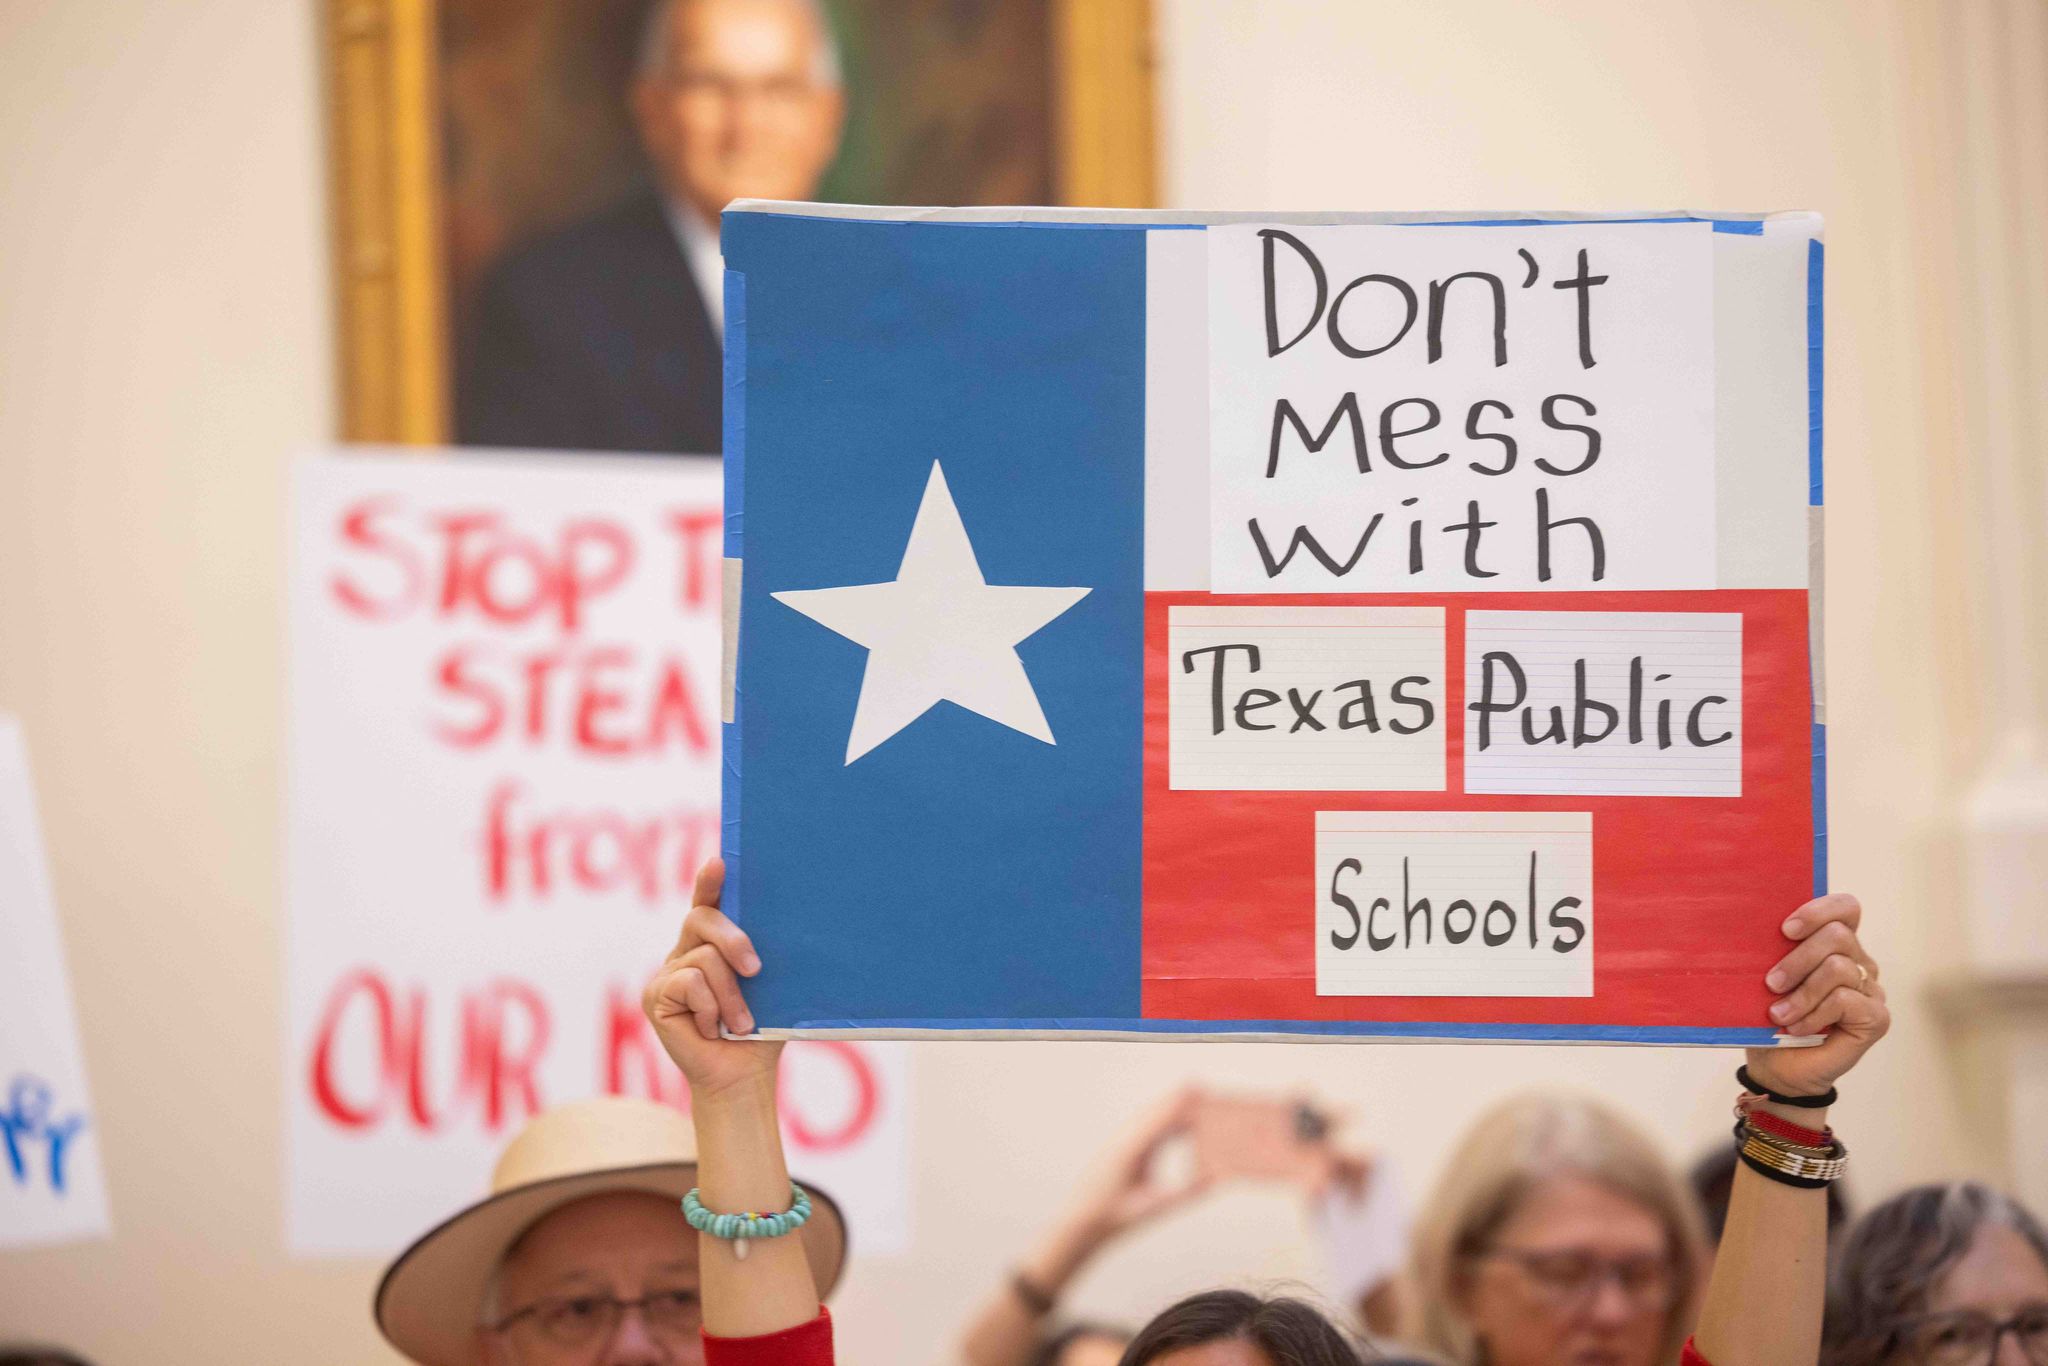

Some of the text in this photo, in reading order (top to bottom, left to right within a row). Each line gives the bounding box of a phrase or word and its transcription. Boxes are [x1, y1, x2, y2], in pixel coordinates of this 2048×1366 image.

[1256, 228, 1609, 370] Don't
[1266, 391, 1602, 479] Mess
[330, 496, 636, 632] STOP
[1248, 487, 1606, 582] with
[432, 644, 720, 752] STEA
[1181, 644, 1733, 753] Texas Public
[1330, 850, 1586, 954] Schools
[310, 966, 553, 1132] OUR
